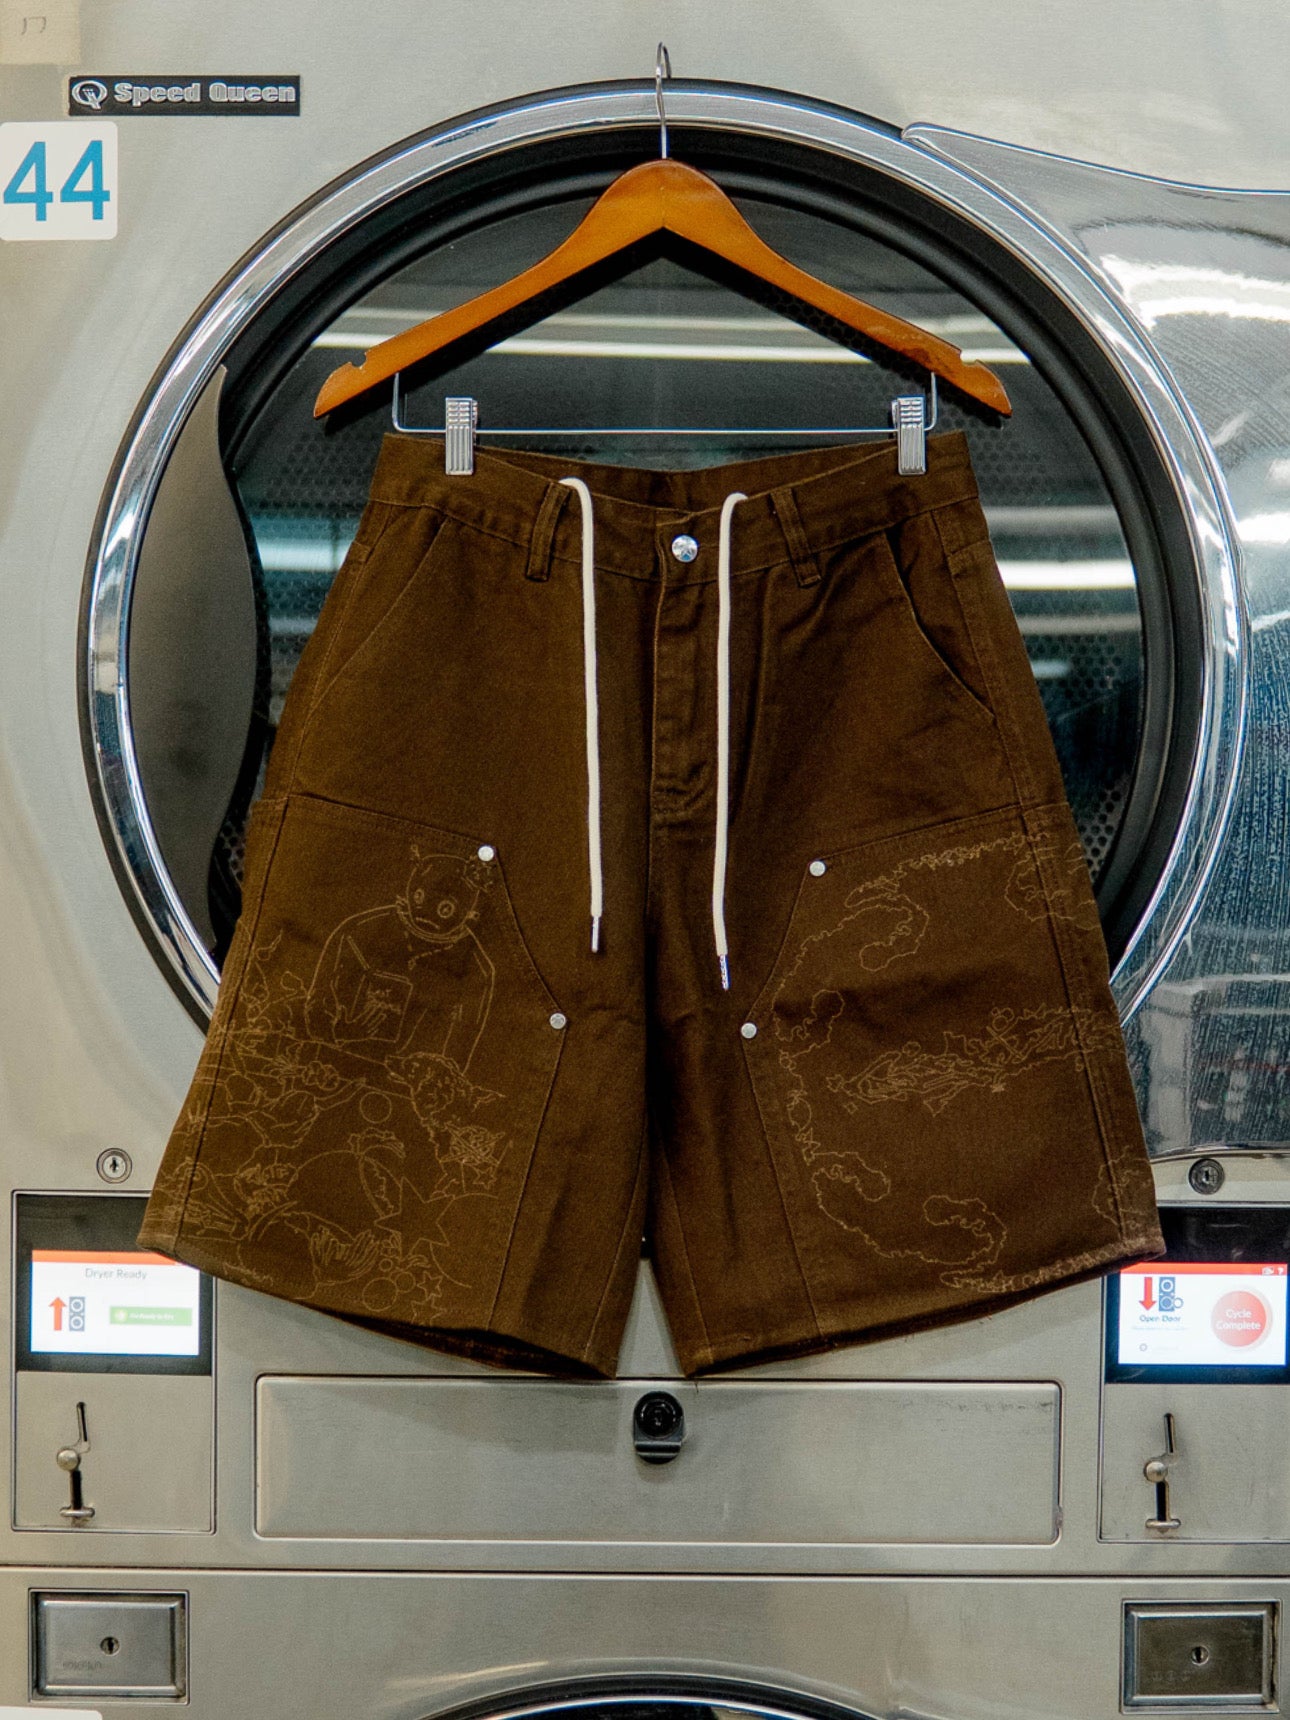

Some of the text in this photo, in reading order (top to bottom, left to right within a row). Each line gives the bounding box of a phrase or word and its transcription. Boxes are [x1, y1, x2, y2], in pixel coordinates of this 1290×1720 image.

[114, 82, 200, 107] Speed
[209, 82, 296, 102] Queen
[3, 140, 110, 221] 44
[85, 1267, 147, 1280] Dryer Ready
[1161, 1314, 1181, 1322] Door
[1225, 1308, 1252, 1319] Cycle
[1215, 1320, 1261, 1331] Complete
